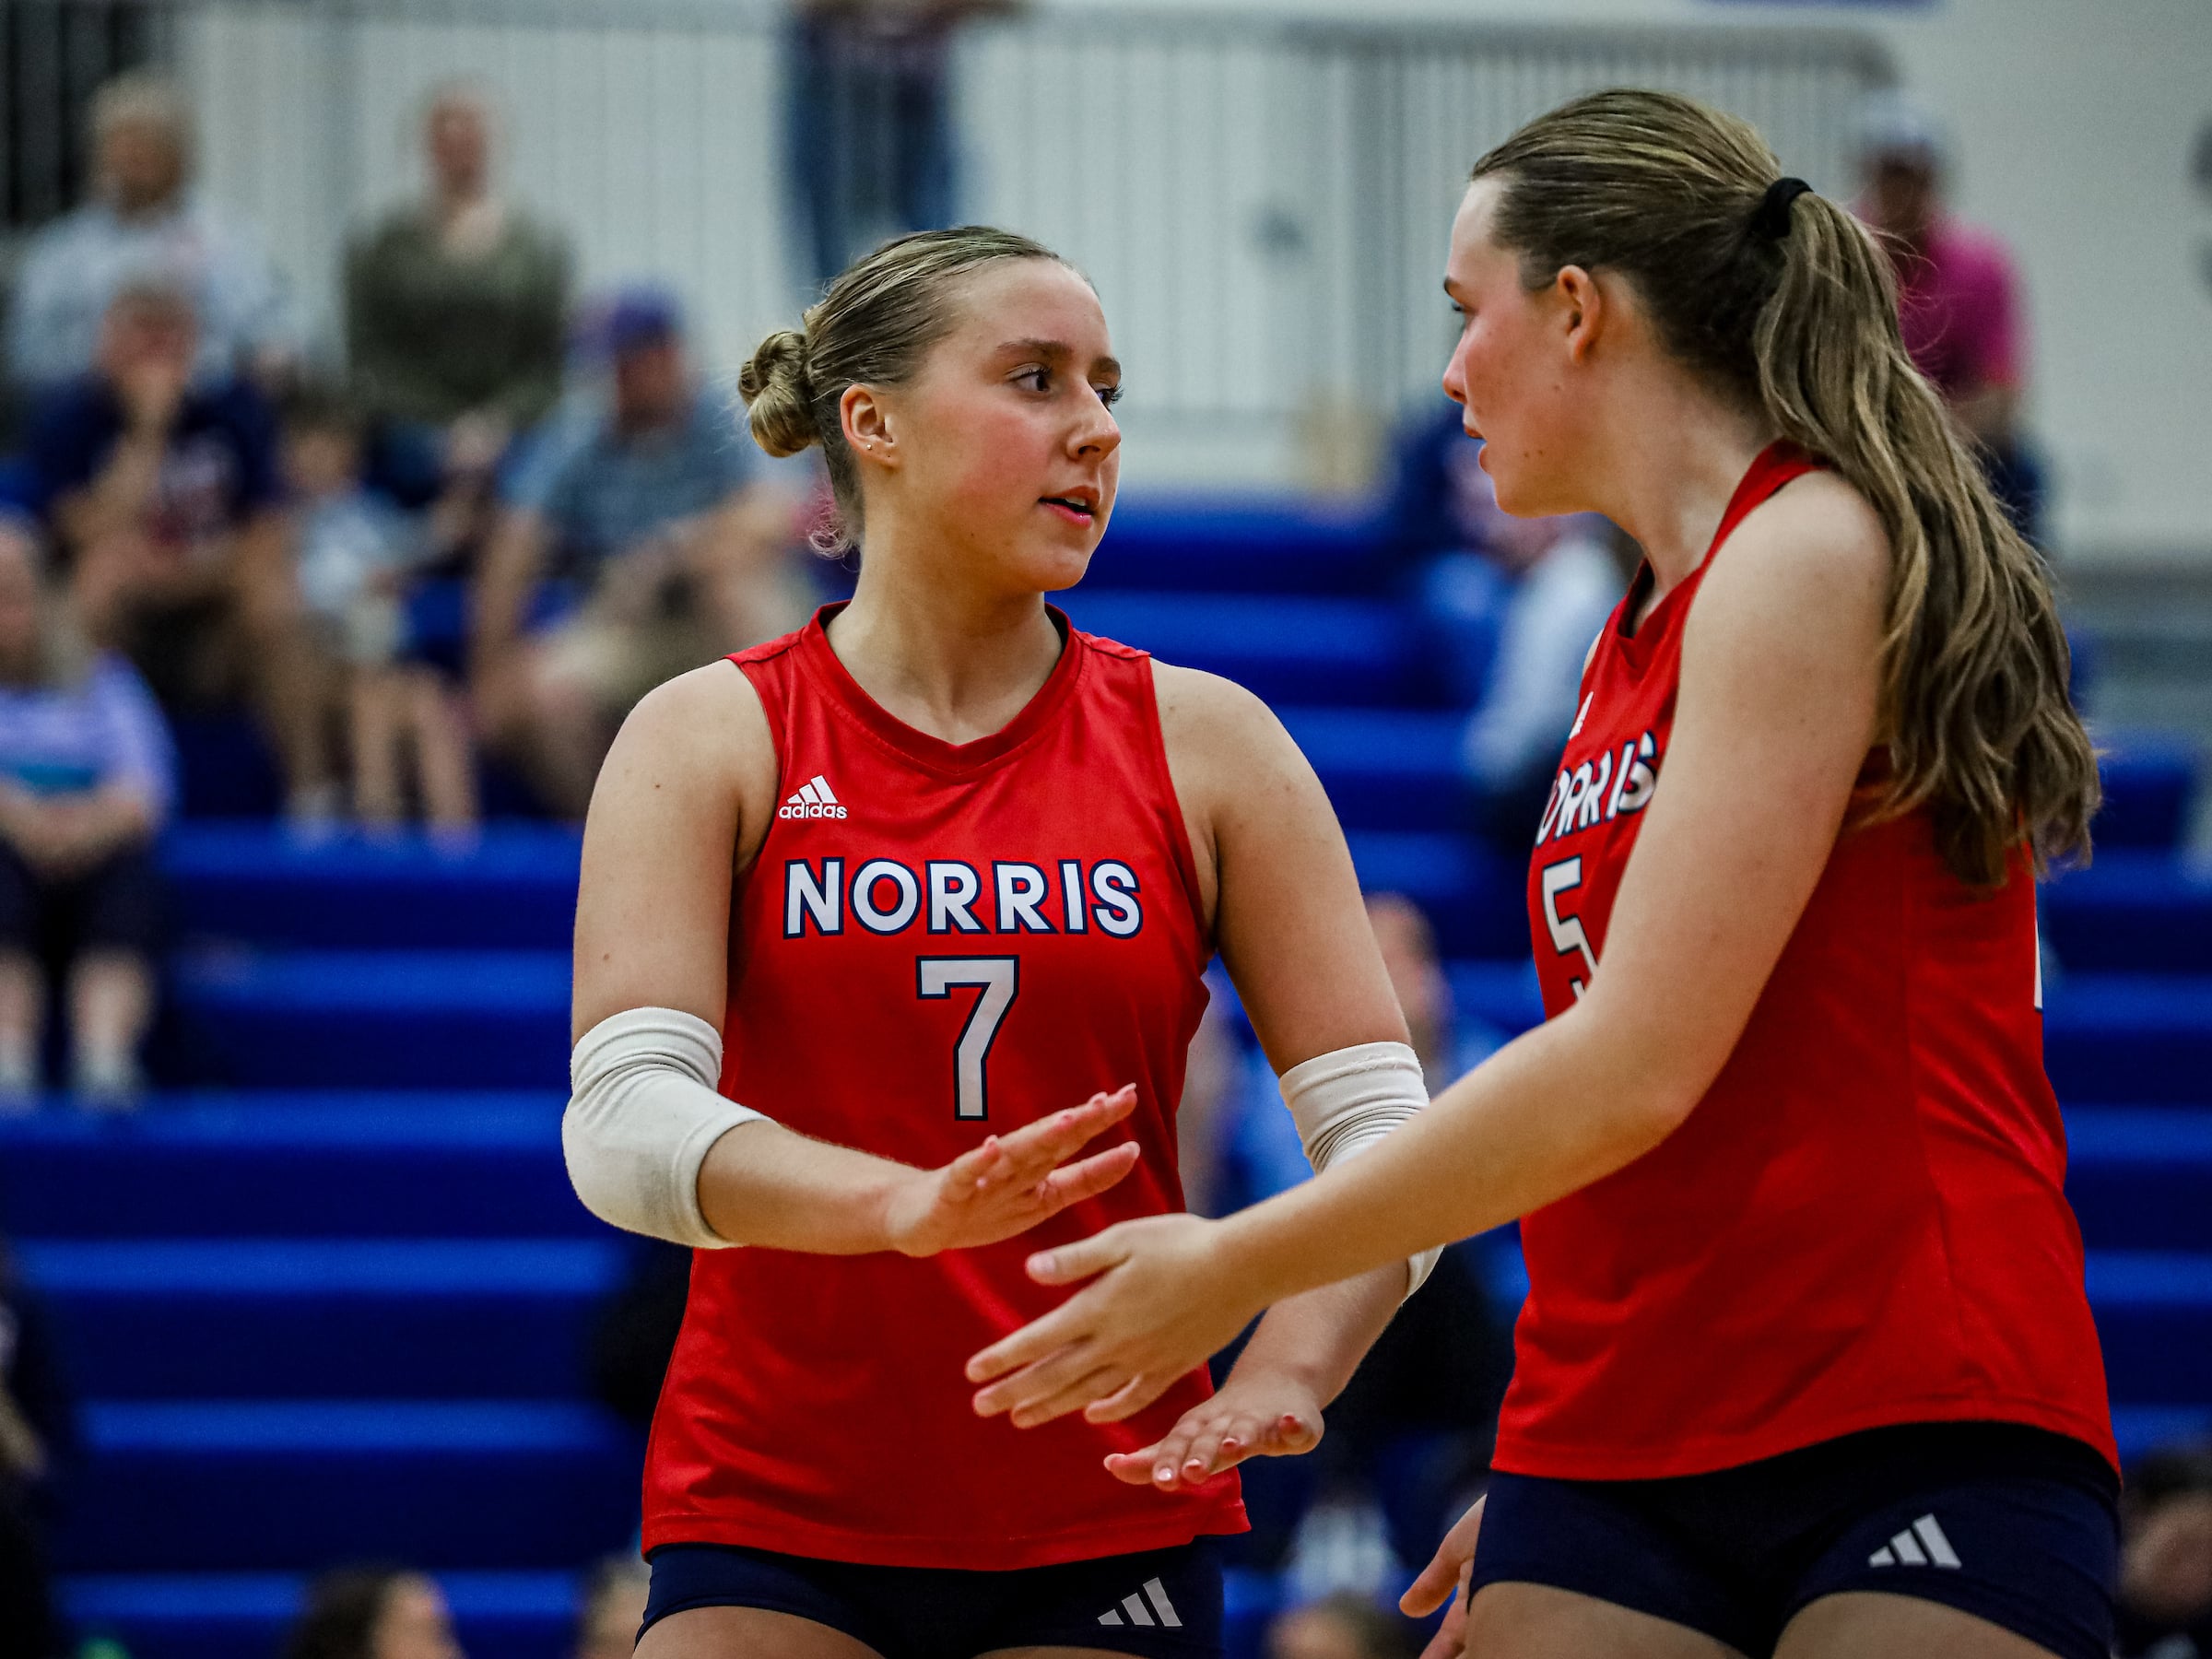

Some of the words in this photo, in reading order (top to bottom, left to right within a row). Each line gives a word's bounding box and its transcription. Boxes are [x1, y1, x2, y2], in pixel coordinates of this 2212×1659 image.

[779, 801, 847, 819] adidas
[1535, 730, 1657, 847] ORRIS
[783, 857, 1142, 939] NORRIS
[1542, 854, 1599, 1001] 5
[916, 956, 1019, 1121] 7
